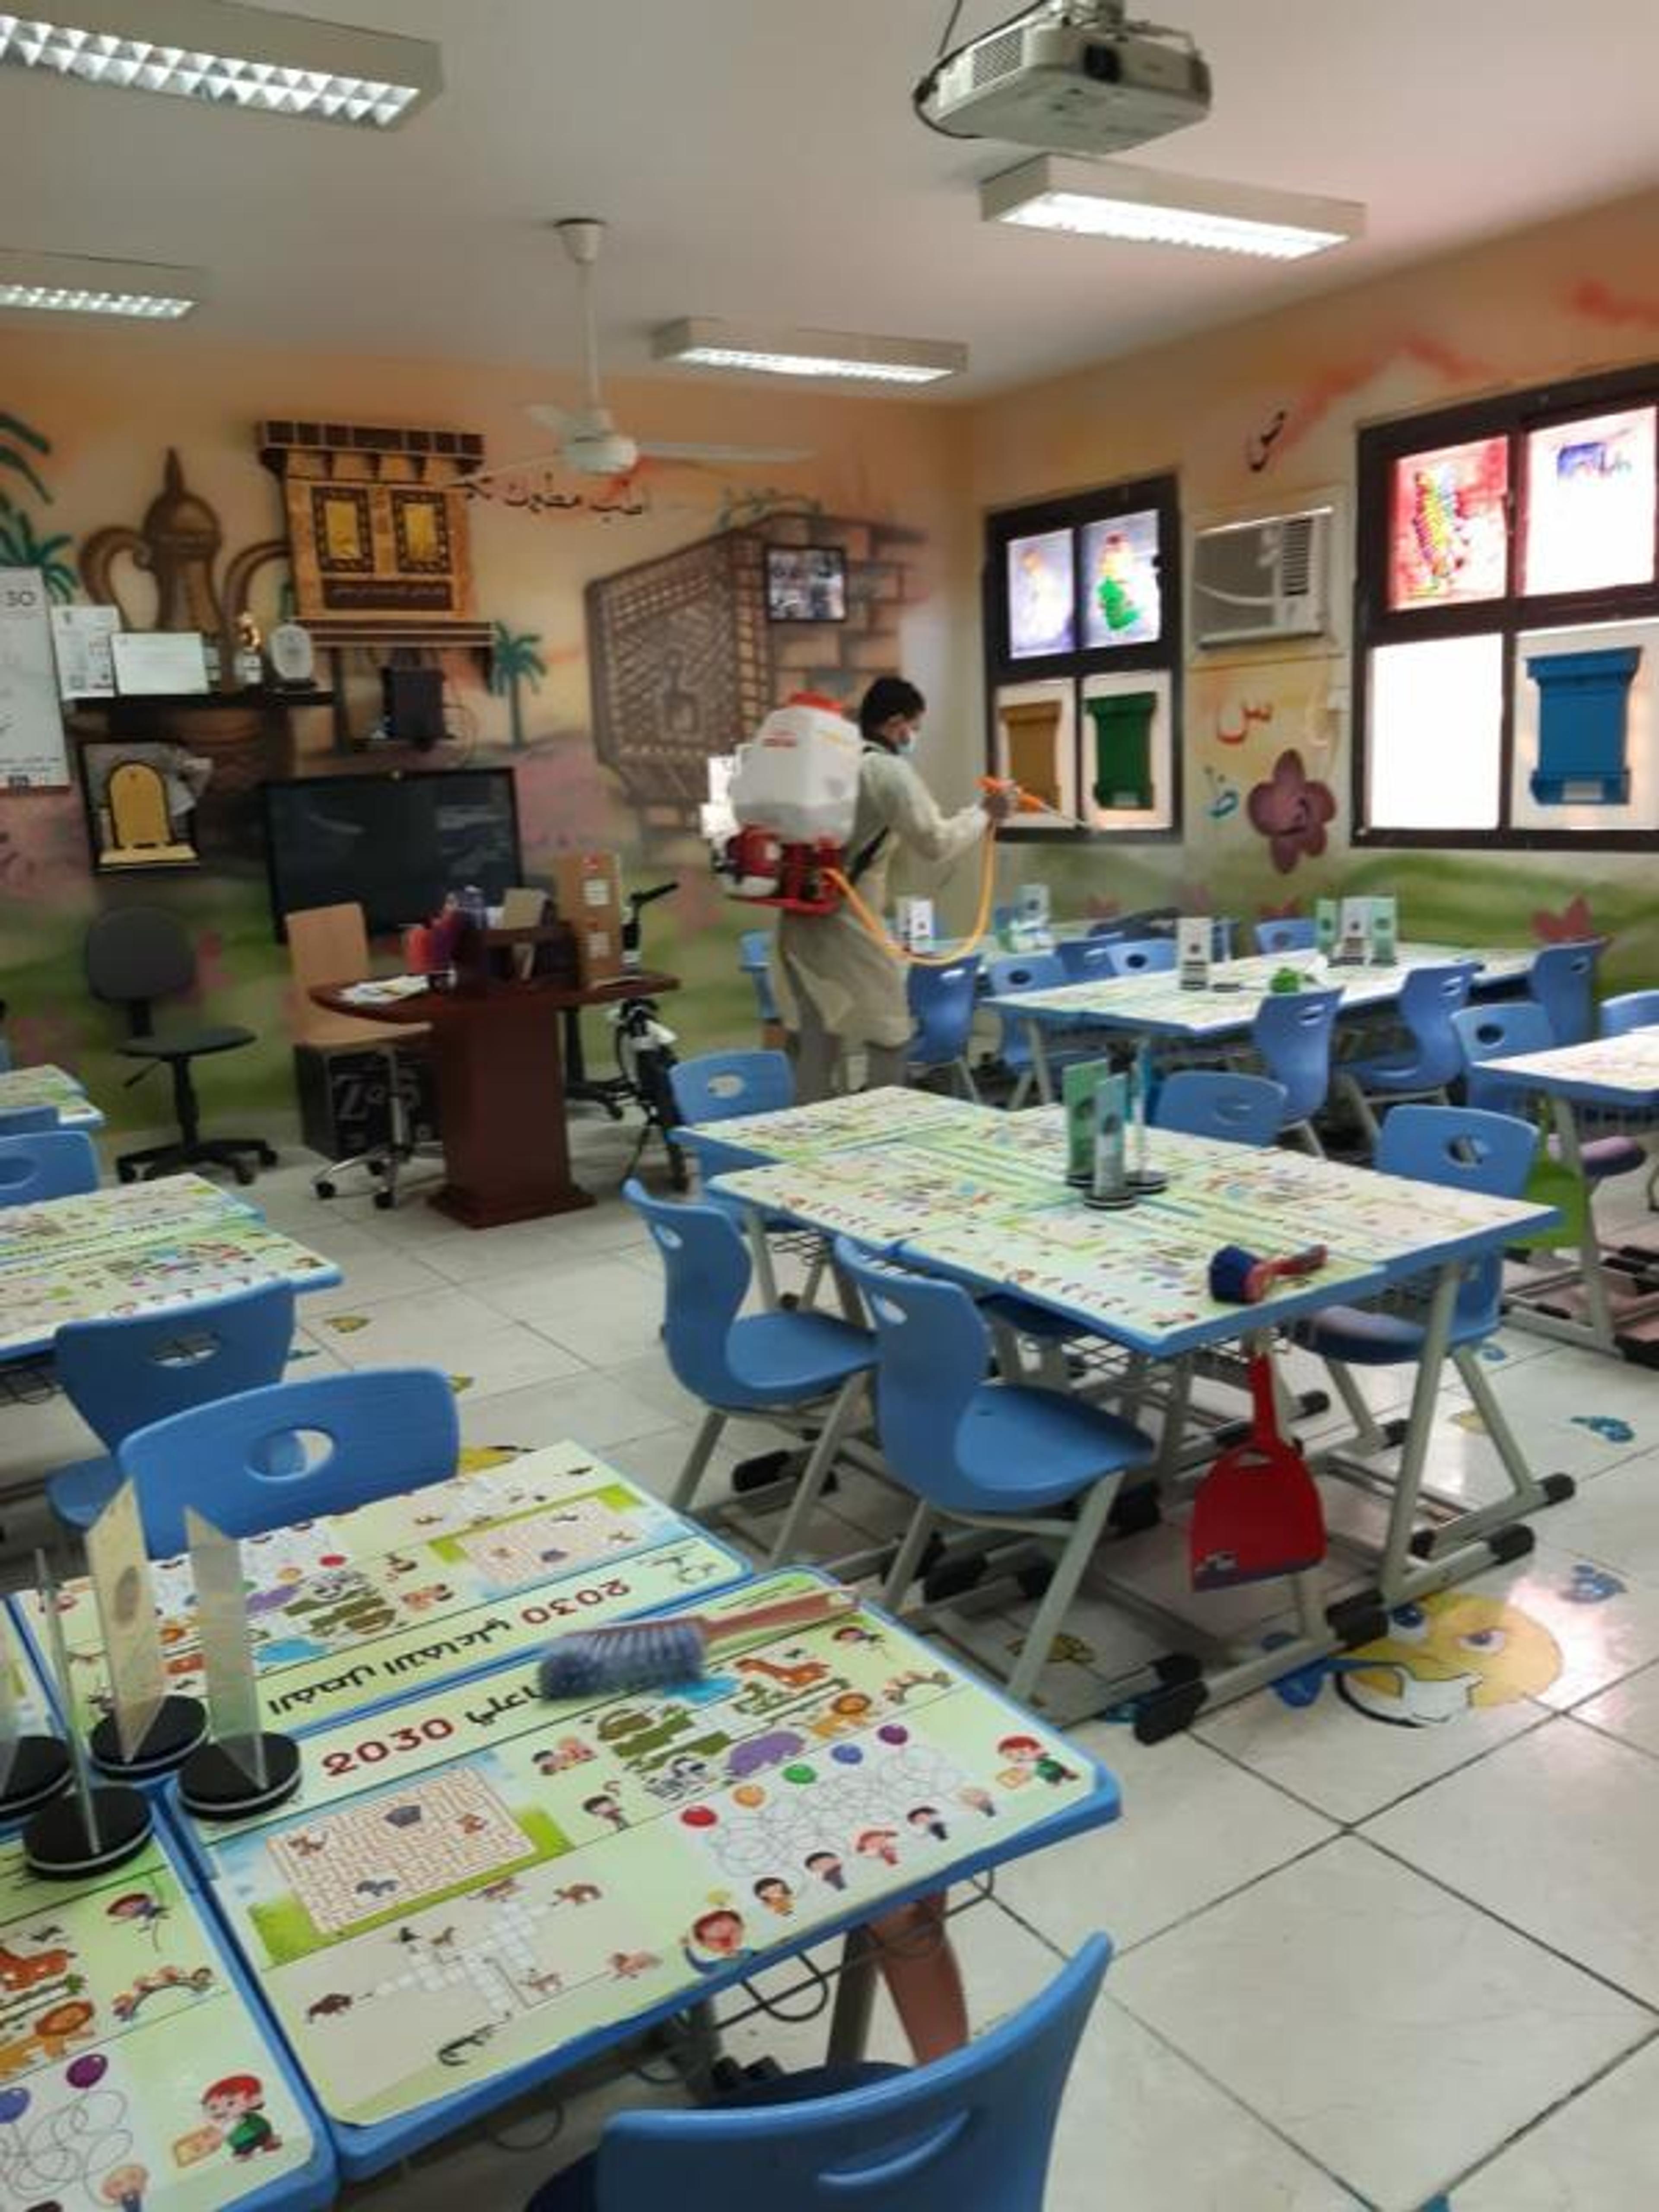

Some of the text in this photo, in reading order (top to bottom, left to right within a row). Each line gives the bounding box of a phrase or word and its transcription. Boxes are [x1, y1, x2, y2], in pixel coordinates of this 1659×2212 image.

[268, 1579, 631, 1716] الفصل التفاعلي 2030
[321, 1717, 454, 1777] 2030
